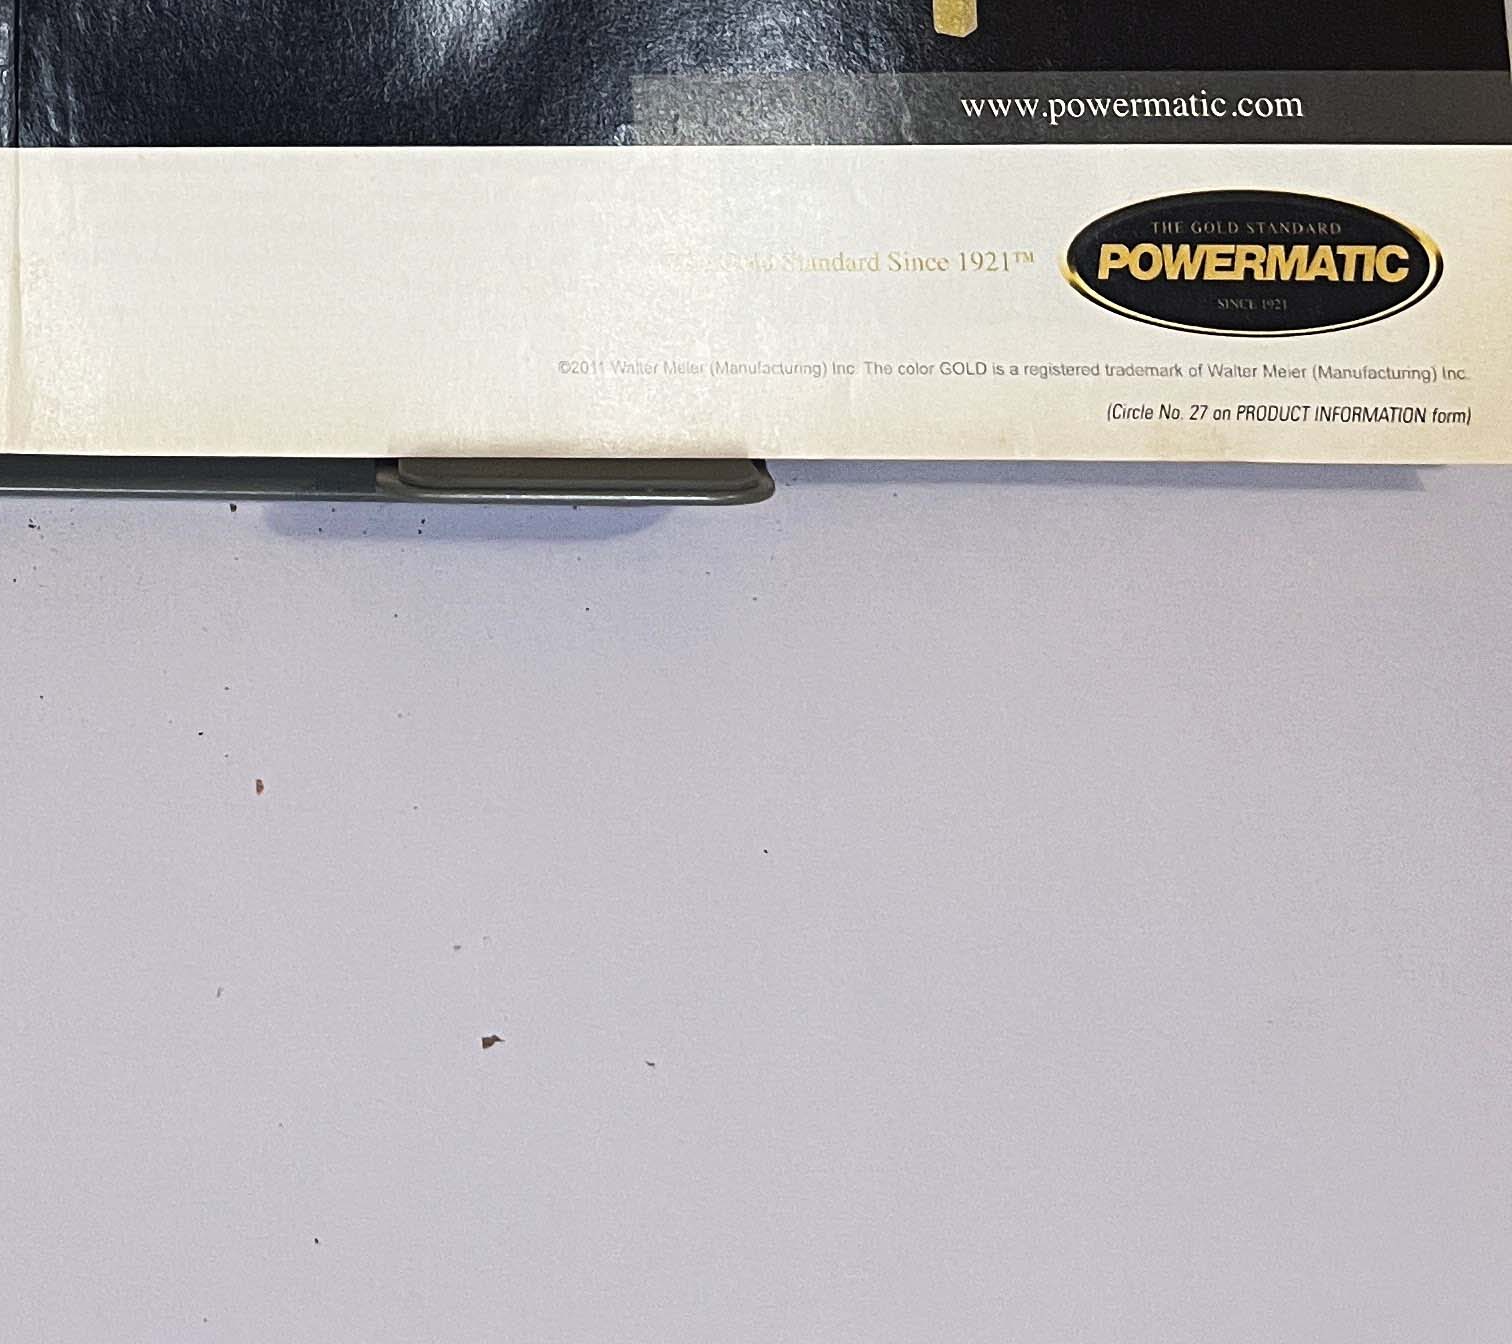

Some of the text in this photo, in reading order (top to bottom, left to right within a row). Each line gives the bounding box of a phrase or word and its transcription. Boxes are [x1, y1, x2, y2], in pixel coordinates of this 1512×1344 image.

[960, 89, 1304, 126] www.powermatic.com
[1151, 221, 1342, 236] THE GOLD STANDARD
[888, 251, 949, 273] Since
[1097, 242, 1410, 283] POWERMATIC
[1217, 297, 1288, 311] SINCE 1921
[898, 362, 934, 376] color
[940, 362, 987, 376] GOLD
[992, 362, 1004, 376] is
[1009, 365, 1019, 376] a
[1024, 363, 1099, 380] registered
[1105, 363, 1183, 378] trademark
[1189, 364, 1202, 378] of
[1207, 364, 1257, 378] Walter
[1313, 364, 1437, 383] (Manufacturing)
[1107, 403, 1472, 426] (Circle No. 27 on PRODUCT INFORMATION form)
